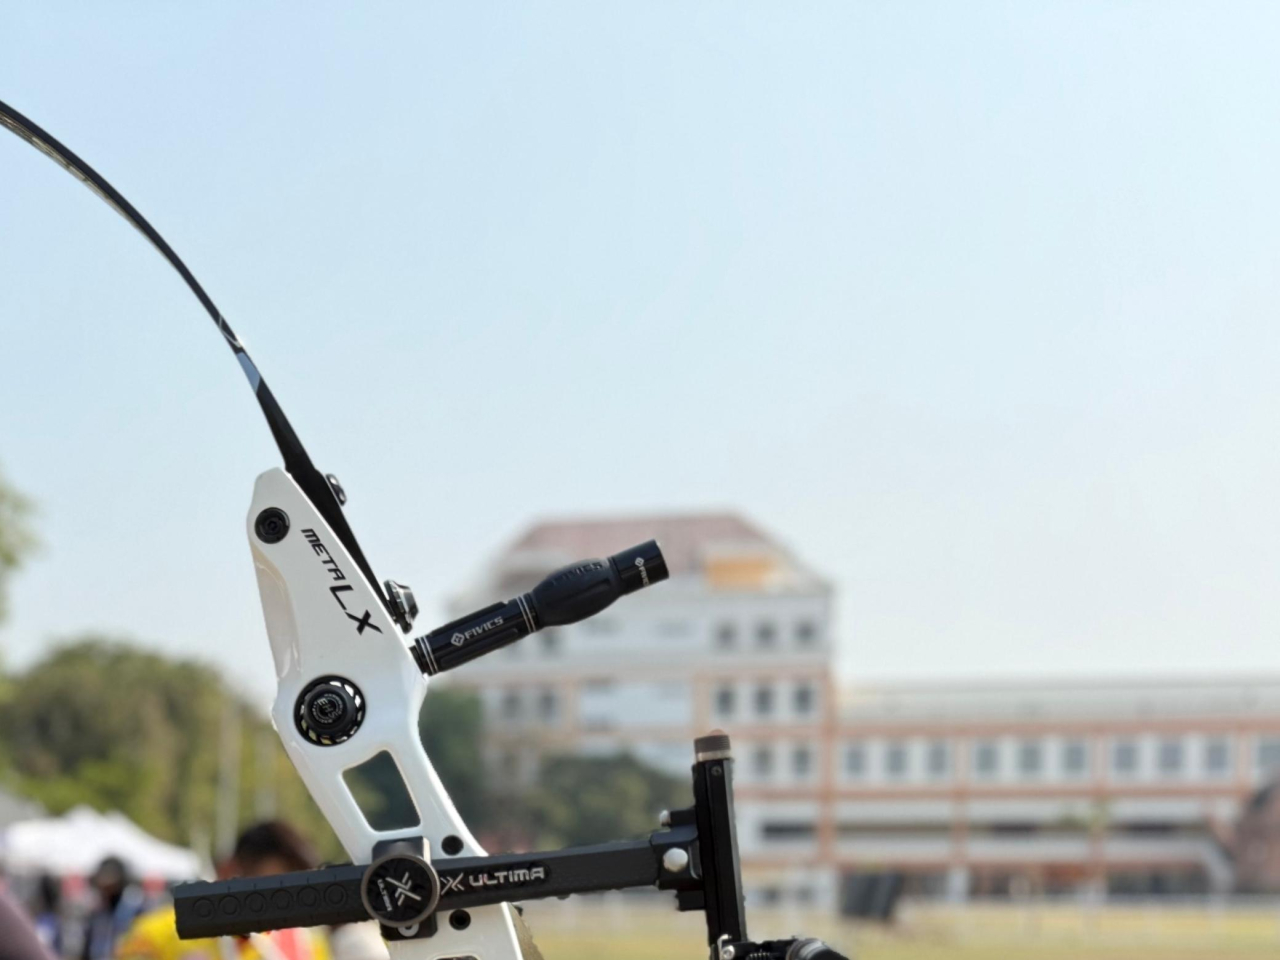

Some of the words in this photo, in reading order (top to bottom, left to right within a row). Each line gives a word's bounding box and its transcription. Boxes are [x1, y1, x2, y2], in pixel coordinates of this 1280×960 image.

[301, 528, 346, 581] META
[465, 616, 504, 640] FIVICS
[469, 867, 546, 887] ULTIMA
